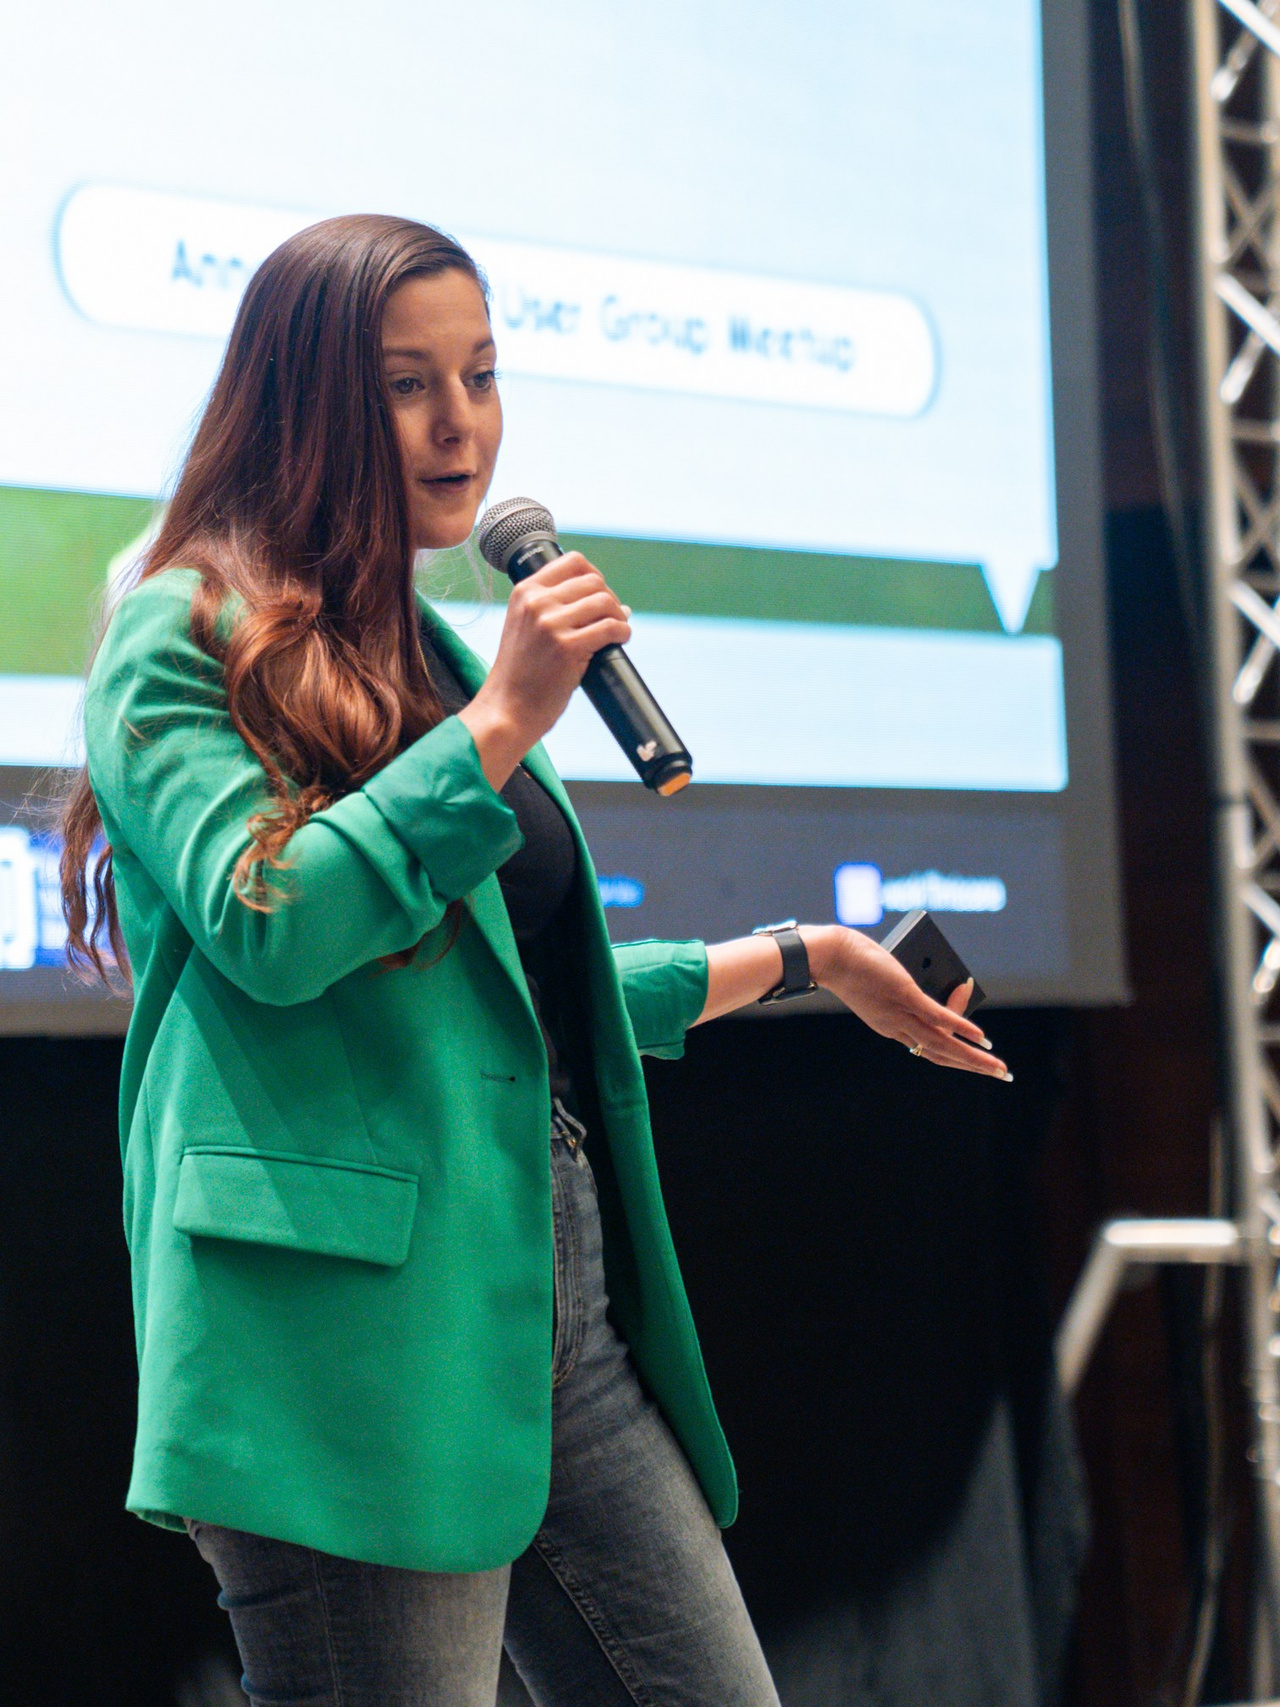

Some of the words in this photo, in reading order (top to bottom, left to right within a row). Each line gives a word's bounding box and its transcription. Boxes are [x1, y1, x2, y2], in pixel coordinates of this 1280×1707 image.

[169, 235, 265, 293] Ann
[500, 282, 582, 336] User
[598, 293, 708, 356] Group
[727, 314, 857, 375] Meetup
